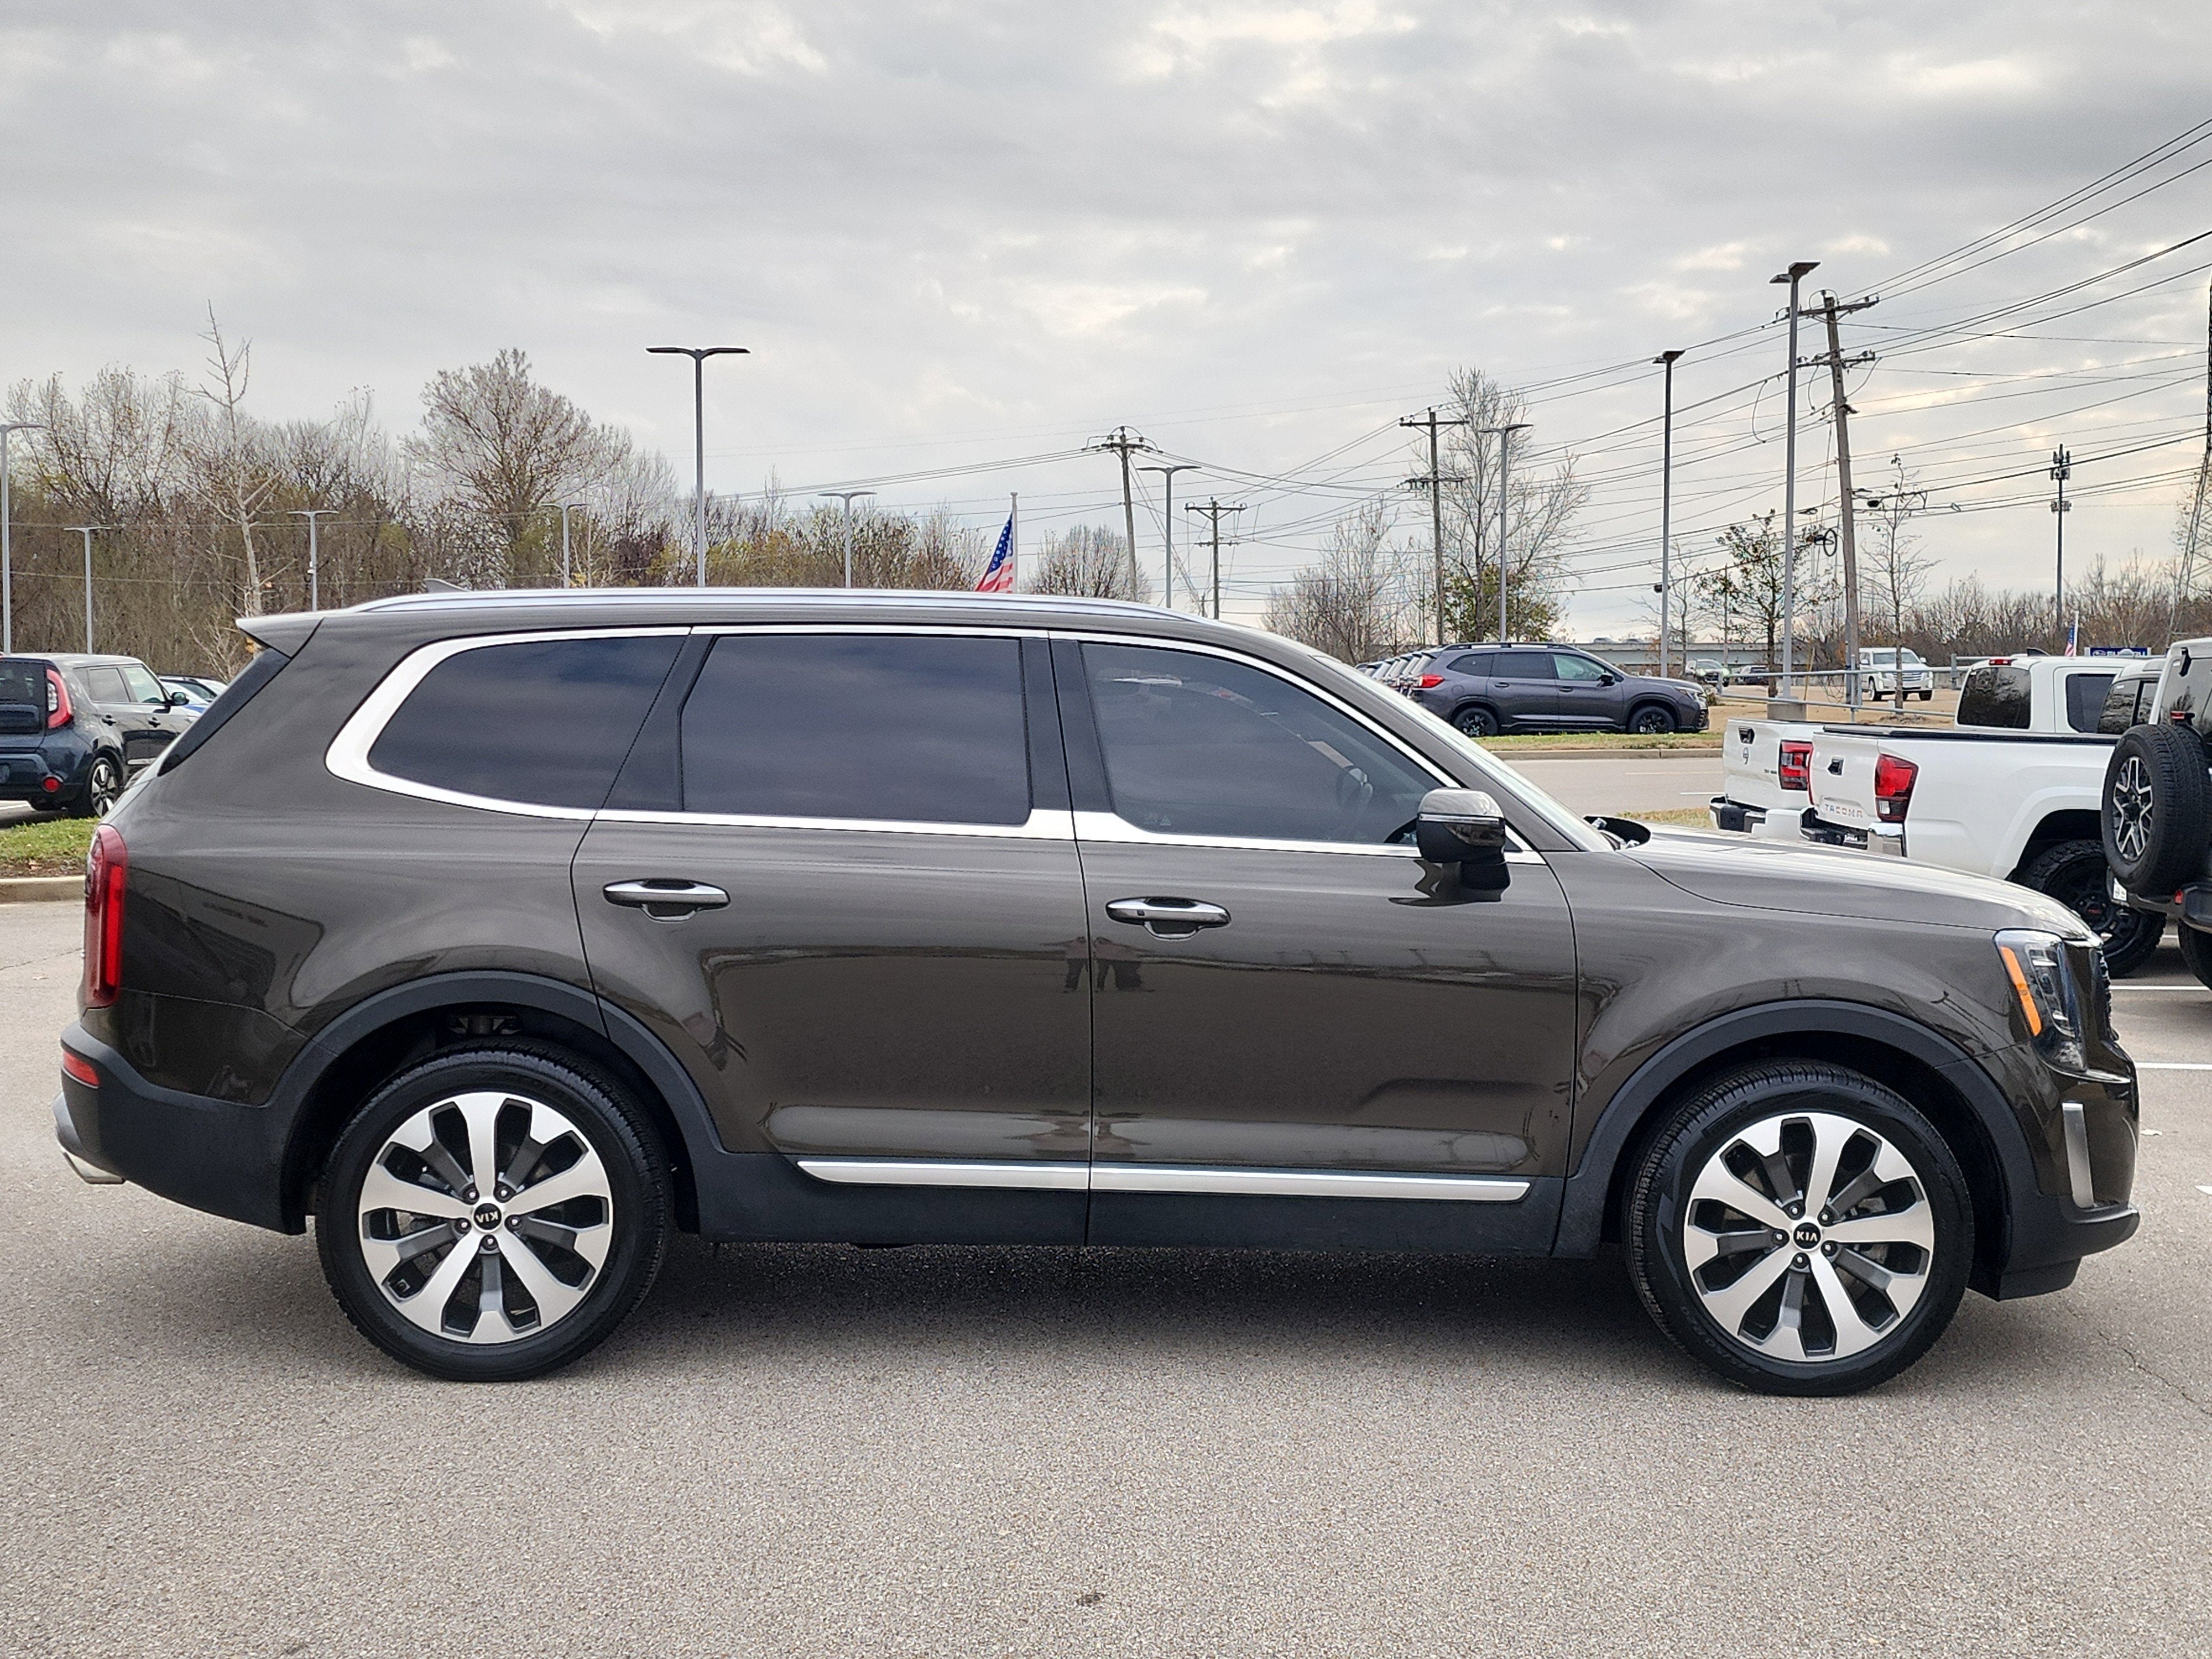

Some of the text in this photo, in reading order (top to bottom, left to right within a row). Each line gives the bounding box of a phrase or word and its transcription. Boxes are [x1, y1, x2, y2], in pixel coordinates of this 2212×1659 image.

[1824, 804, 1863, 818] TACOMA
[476, 1211, 499, 1223] KIA
[1796, 1230, 1818, 1242] KIA
